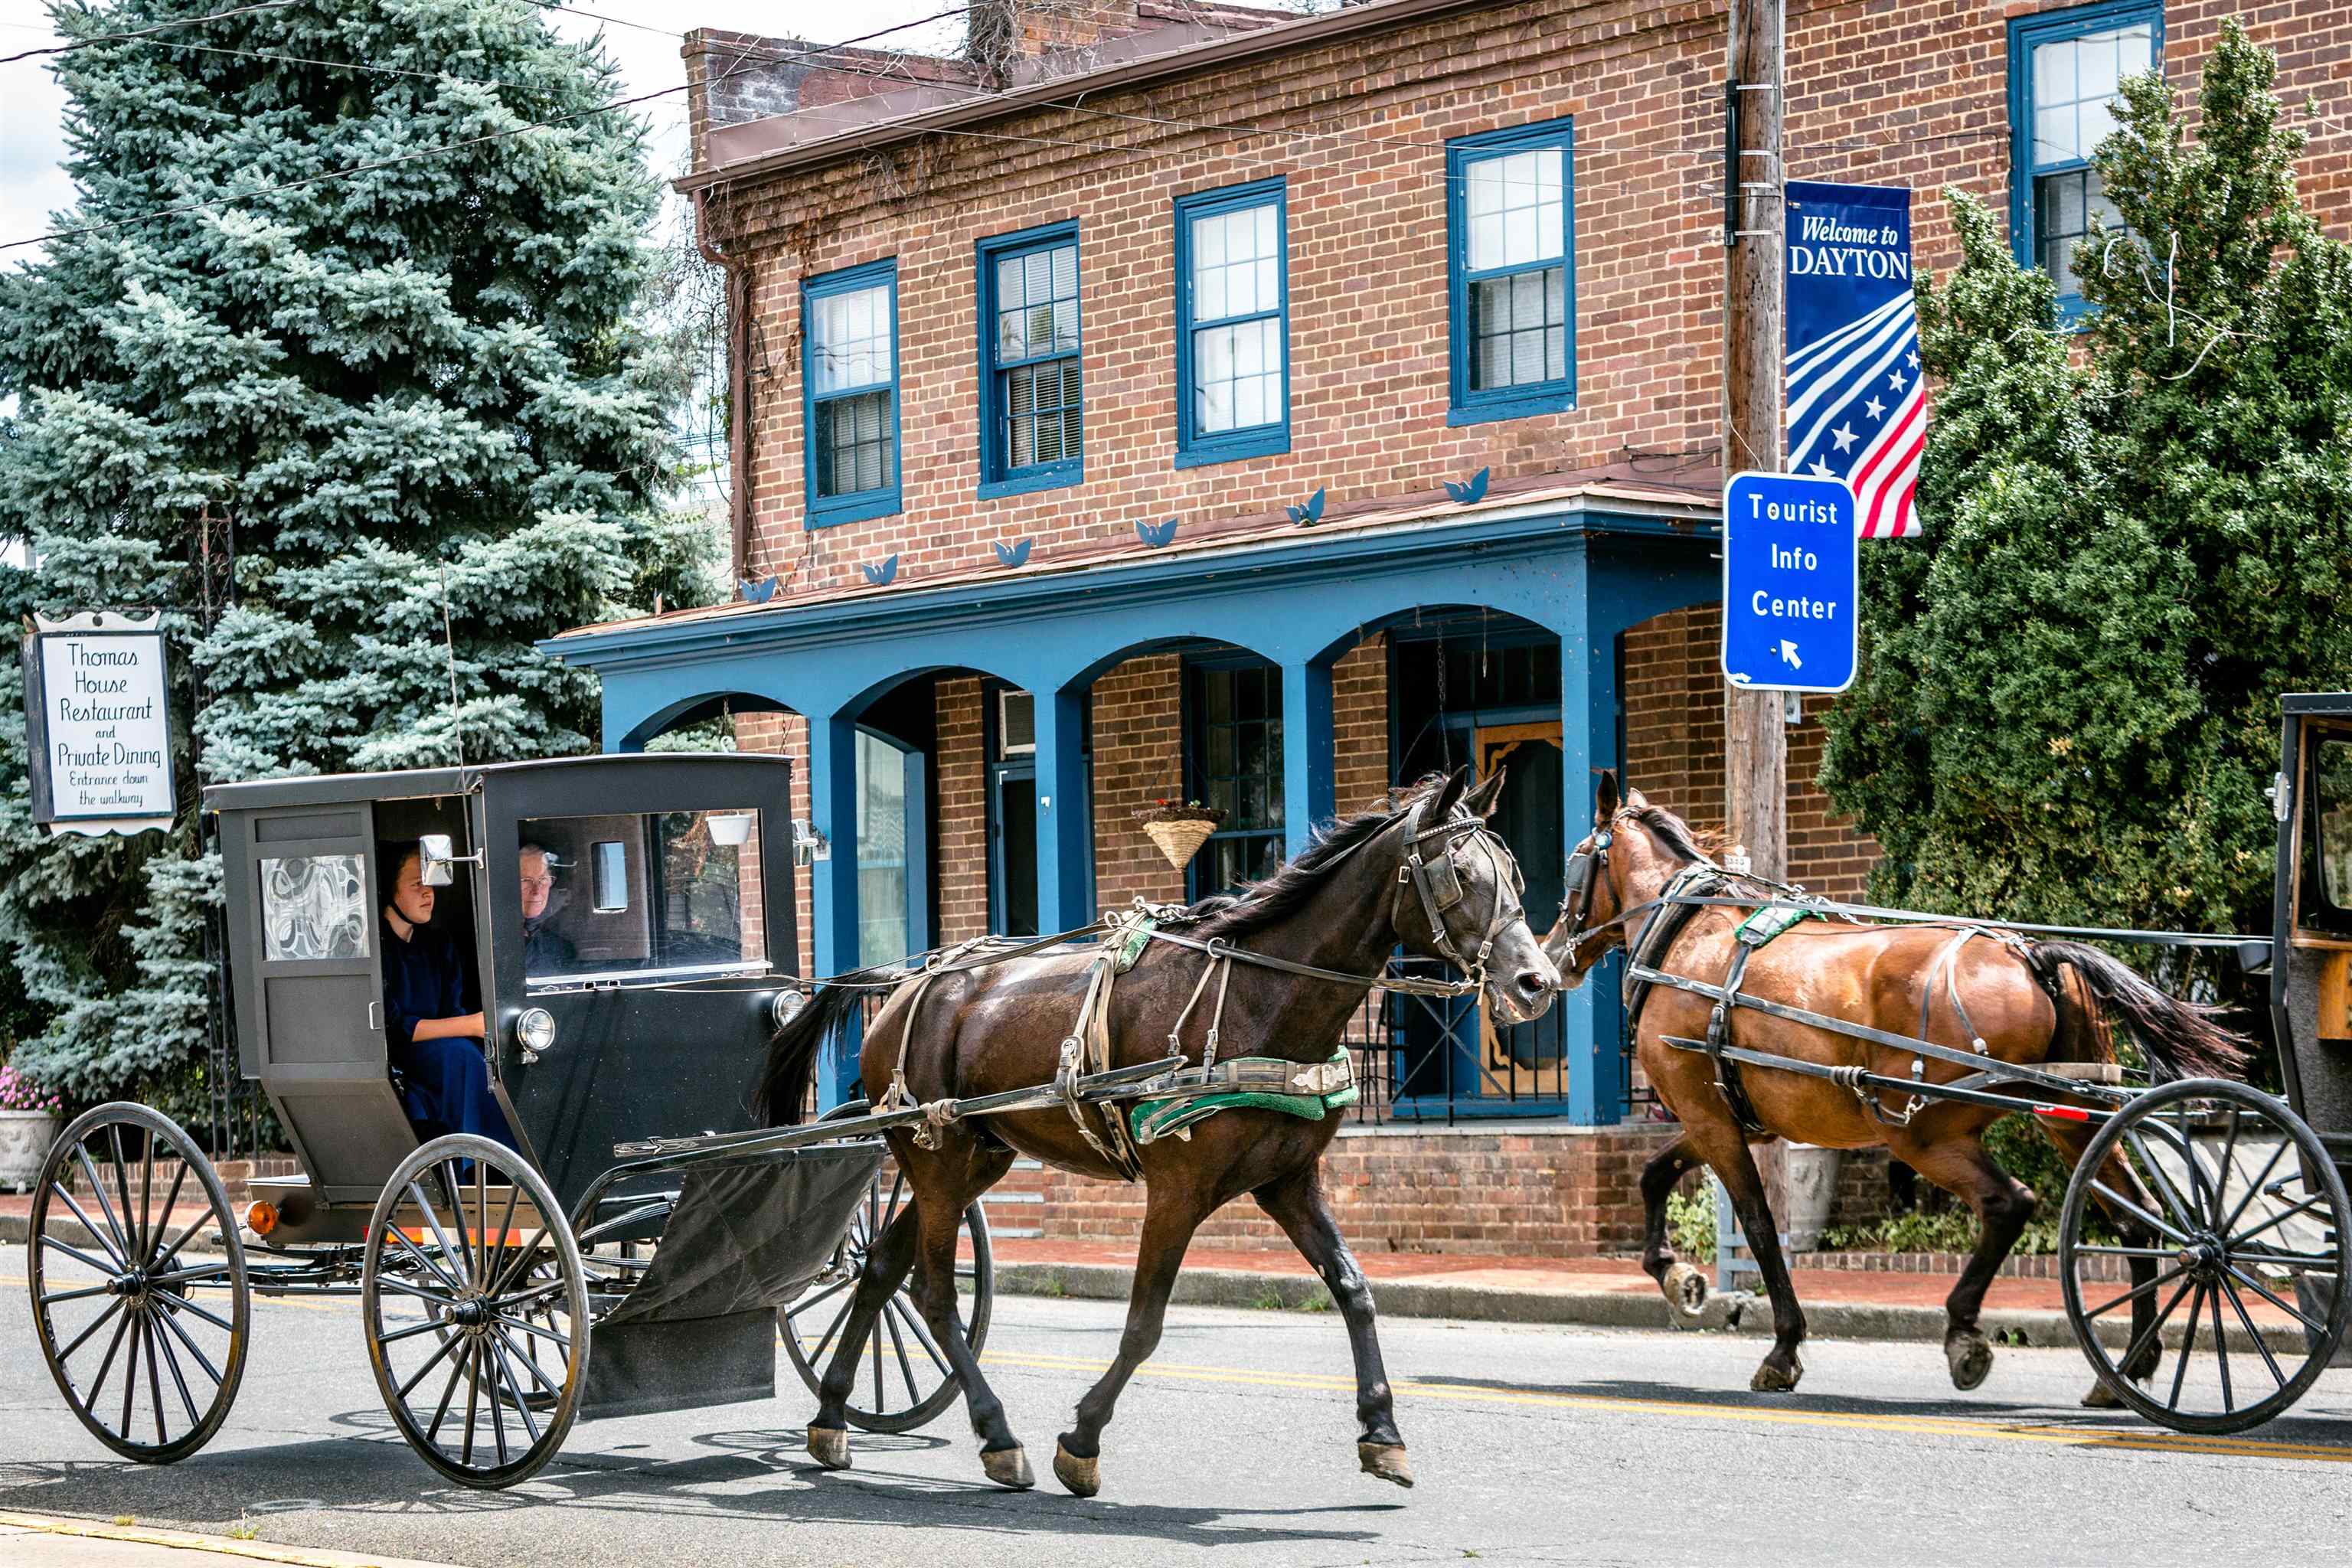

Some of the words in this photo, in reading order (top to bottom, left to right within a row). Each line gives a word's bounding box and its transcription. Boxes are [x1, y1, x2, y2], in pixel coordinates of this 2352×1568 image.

[1802, 216, 1877, 245] Welcome
[1880, 226, 1898, 245] to
[1789, 246, 1908, 280] DAYTON
[1748, 493, 1838, 524] Tourist
[1772, 543, 1817, 570] Info
[1752, 590, 1837, 619] Center
[67, 643, 139, 666] Thomas
[75, 671, 128, 694] House
[60, 697, 152, 722] Restaurant
[95, 725, 116, 739] and
[58, 743, 109, 767] Private
[114, 743, 161, 769] Dining
[69, 770, 118, 786] Entrance
[122, 769, 149, 785] down
[80, 789, 96, 805] the
[100, 789, 143, 807] walkway
